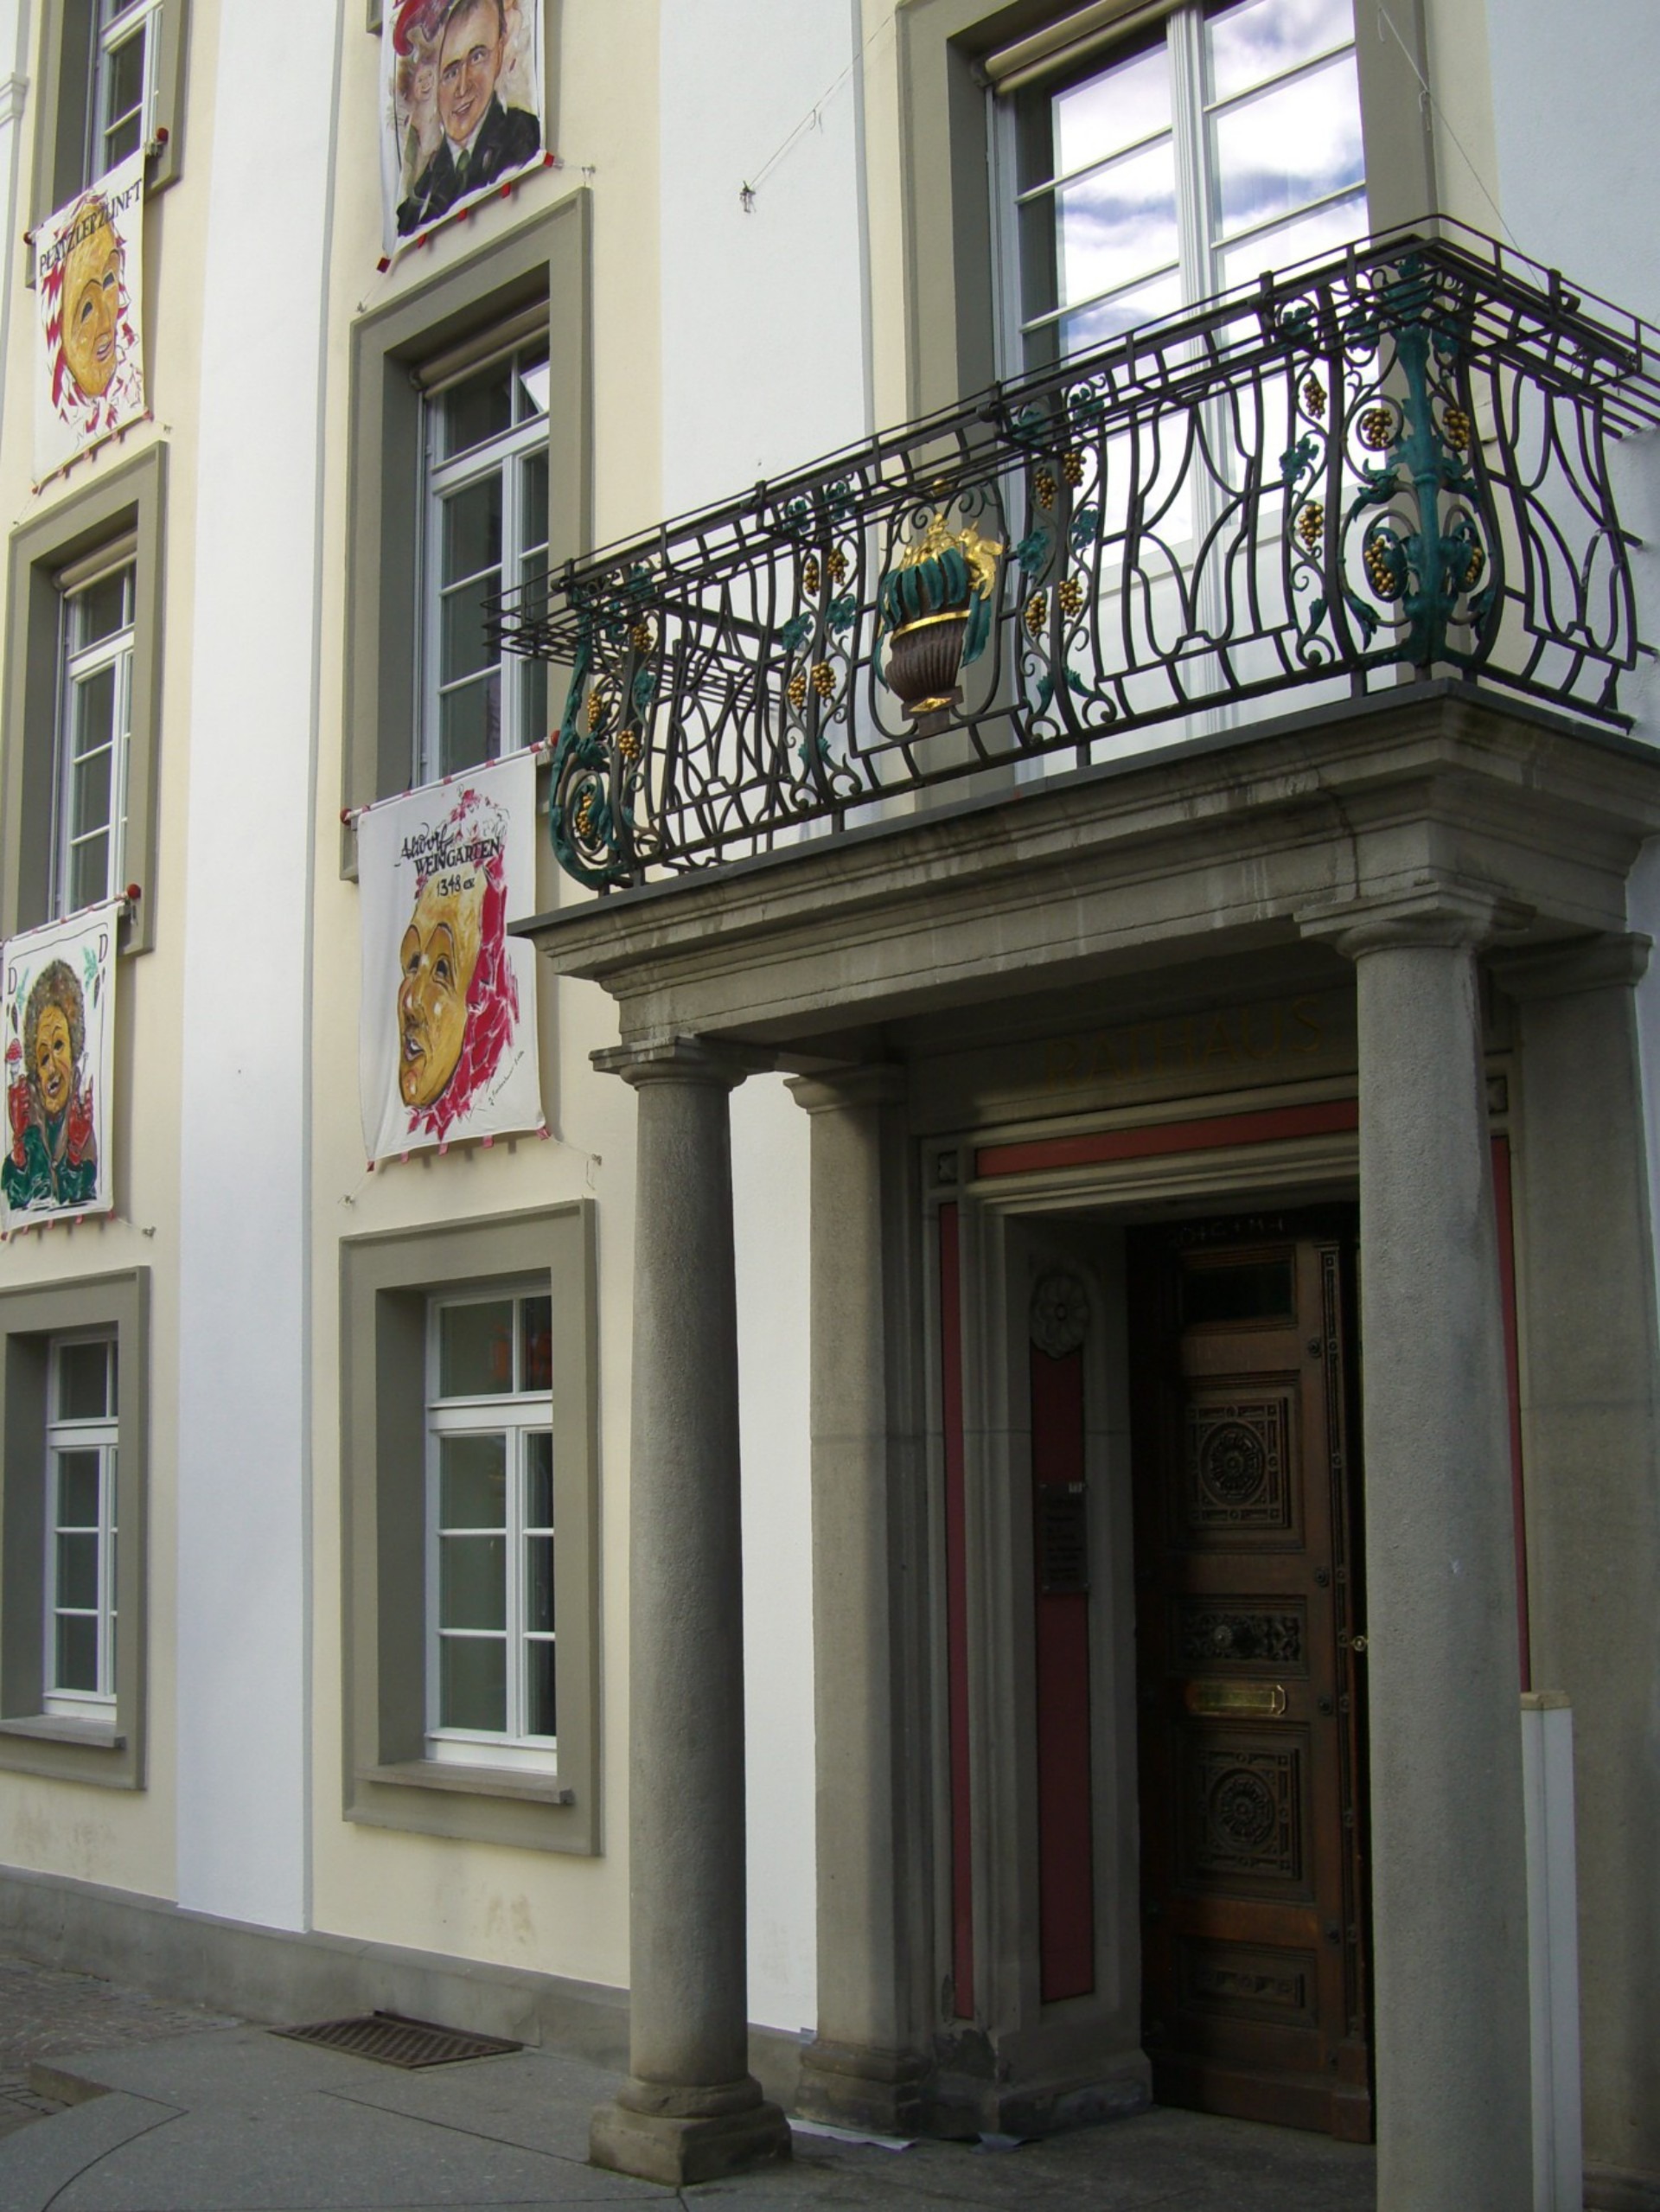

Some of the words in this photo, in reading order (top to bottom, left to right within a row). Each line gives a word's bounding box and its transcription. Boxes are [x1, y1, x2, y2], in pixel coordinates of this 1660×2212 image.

[414, 836, 501, 876] WEINGARTEN
[437, 874, 461, 897] 1348
[99, 933, 109, 963] D
[8, 967, 17, 995] D
[1044, 994, 1325, 1091] RATHAUS
